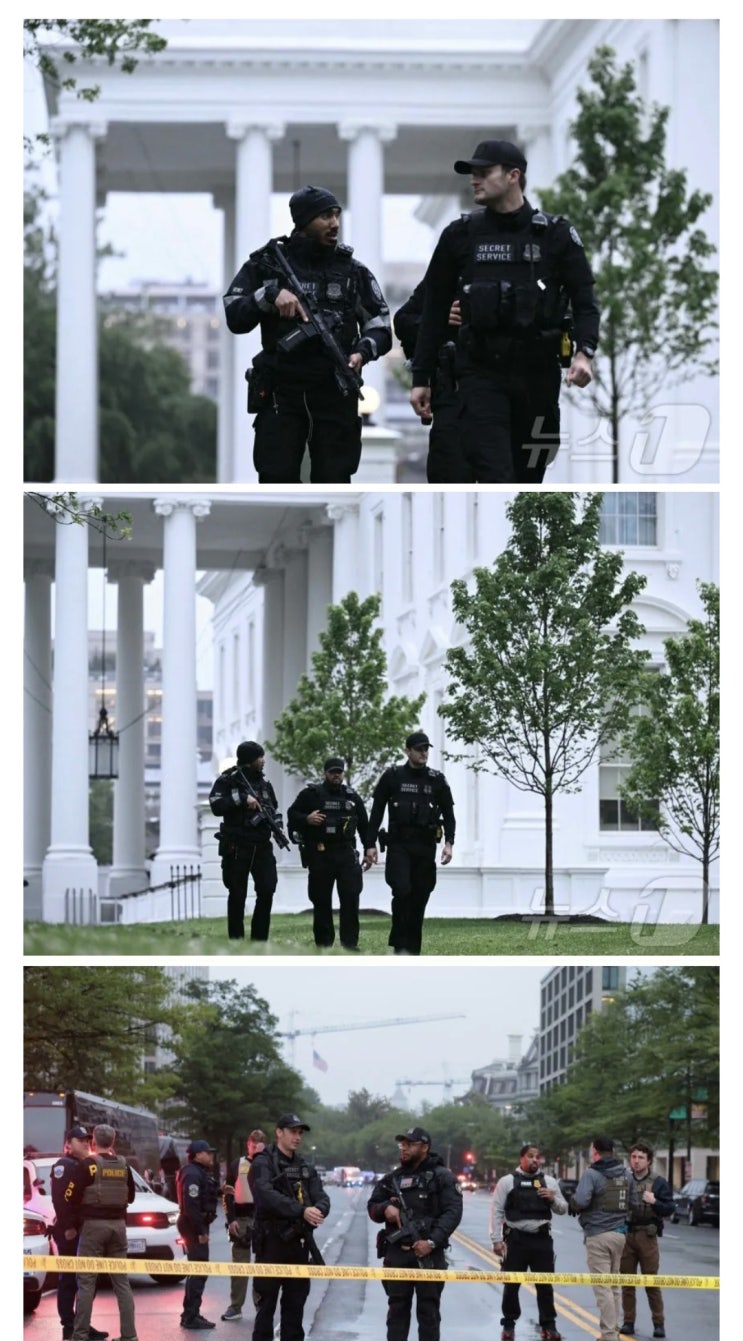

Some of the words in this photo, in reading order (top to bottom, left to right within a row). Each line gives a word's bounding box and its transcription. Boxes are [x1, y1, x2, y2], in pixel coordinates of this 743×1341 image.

[478, 244, 511, 252] SECRET
[476, 253, 511, 261] SERVICE
[102, 1168, 126, 1177] POLICE
